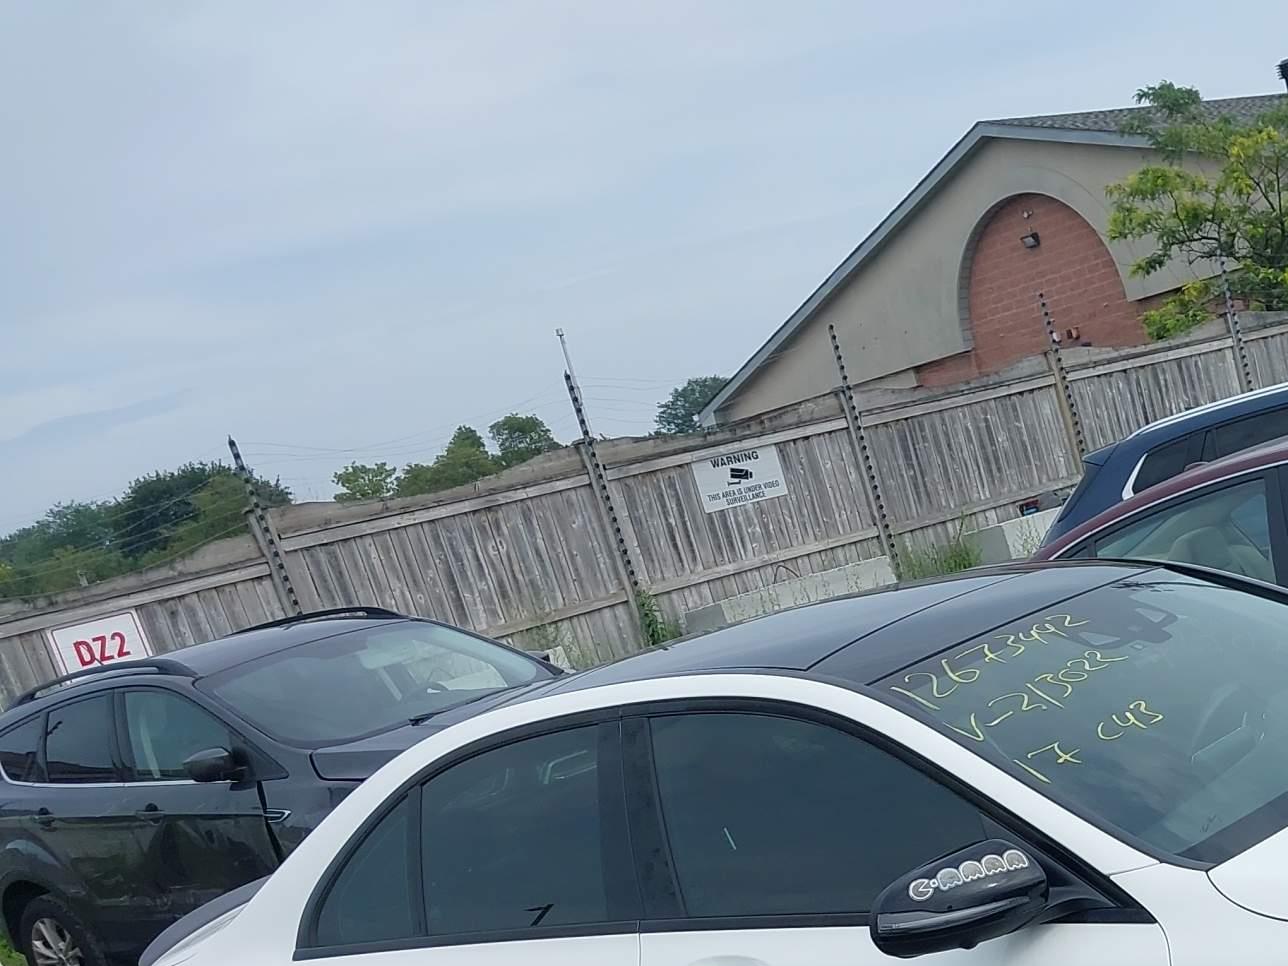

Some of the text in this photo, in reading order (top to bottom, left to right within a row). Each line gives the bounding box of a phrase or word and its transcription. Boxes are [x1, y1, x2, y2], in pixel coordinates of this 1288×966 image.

[710, 451, 759, 468] WARNING
[707, 493, 721, 502] THIS
[722, 489, 737, 499] AREA
[744, 483, 763, 494] UNDER
[763, 480, 780, 489] VIDEO
[726, 491, 767, 506] SURVEILLANCE
[73, 632, 131, 667] DZ2
[1013, 741, 1083, 783] 17
